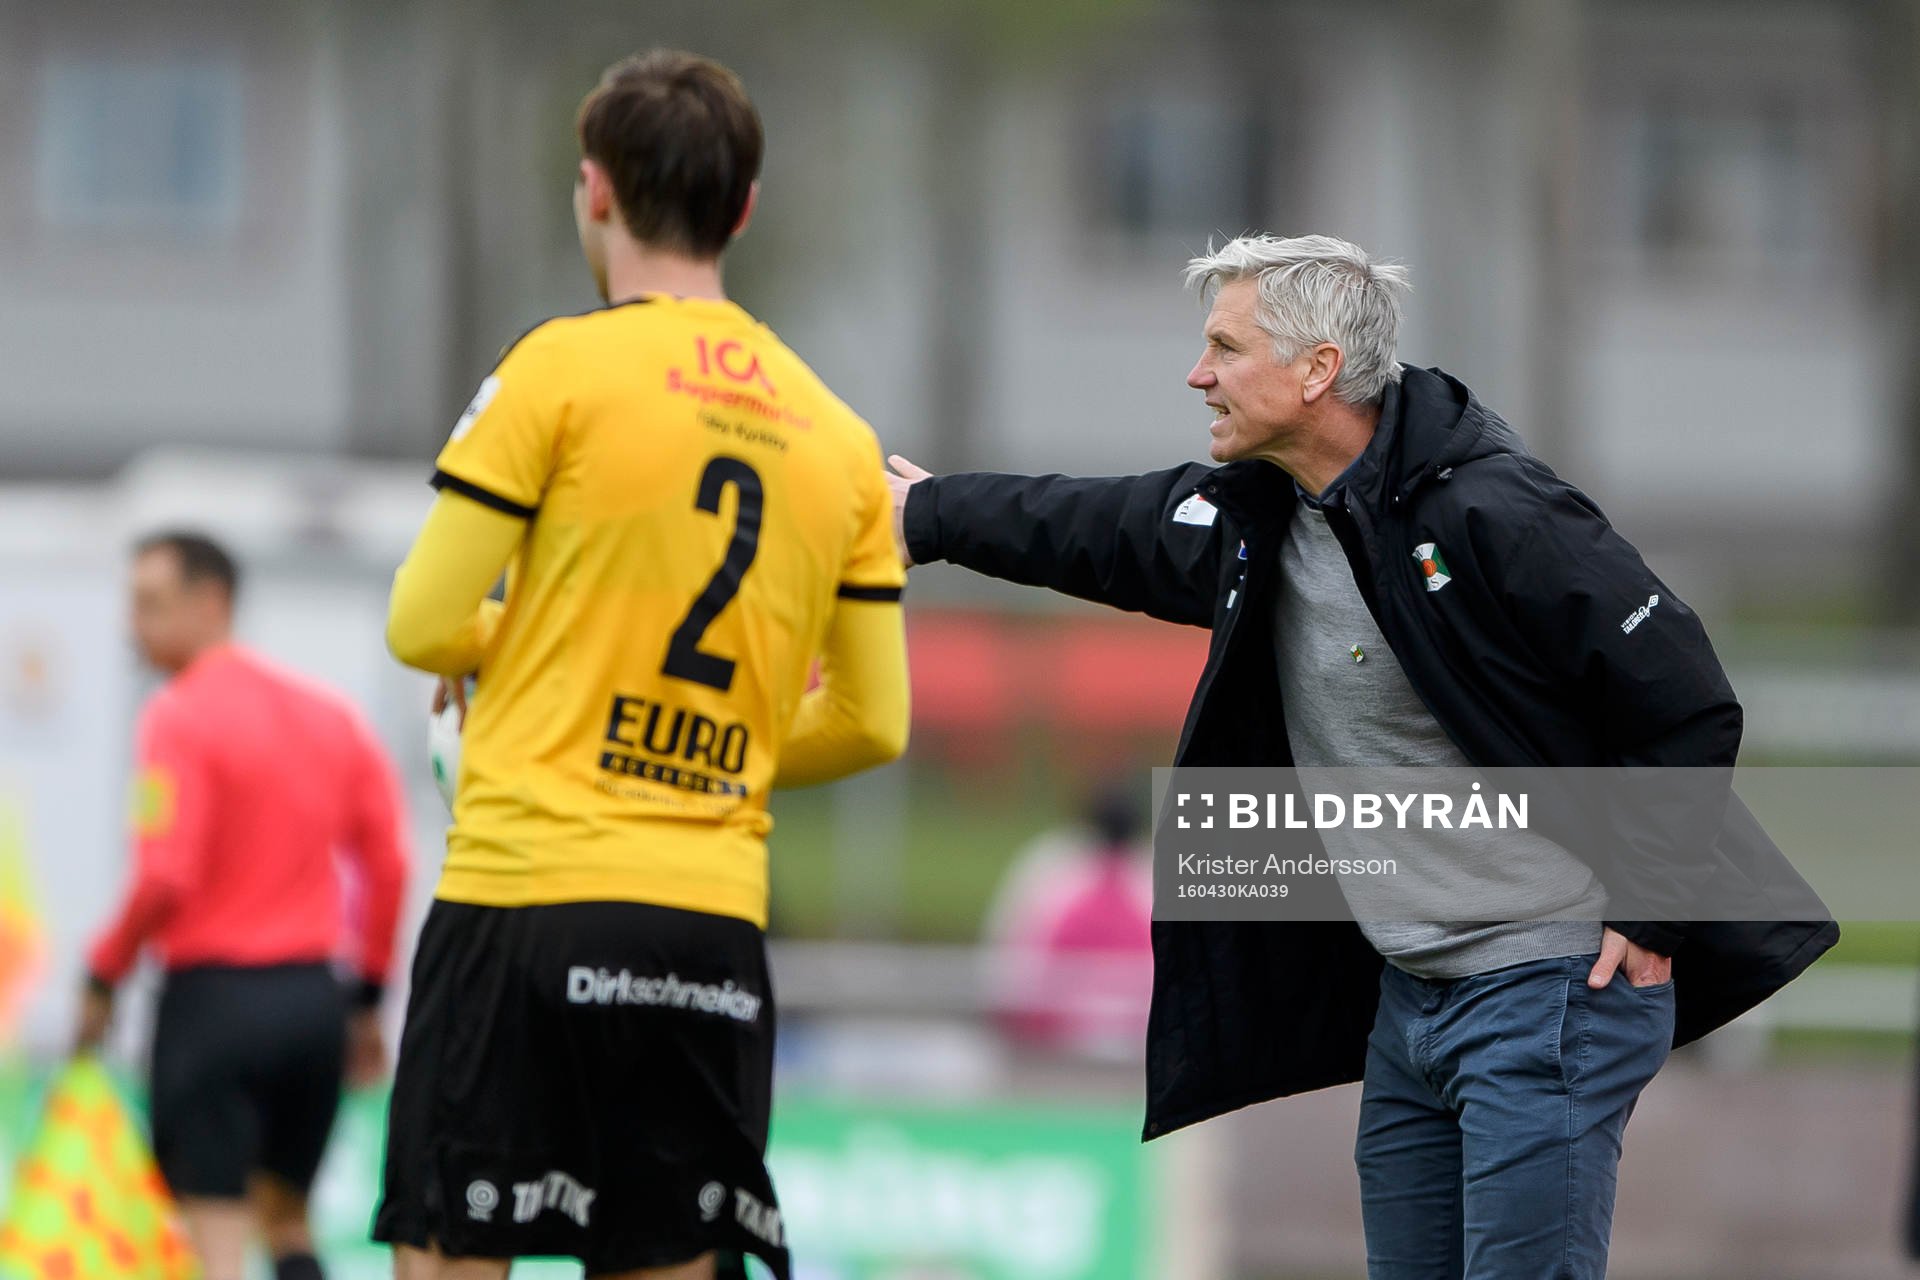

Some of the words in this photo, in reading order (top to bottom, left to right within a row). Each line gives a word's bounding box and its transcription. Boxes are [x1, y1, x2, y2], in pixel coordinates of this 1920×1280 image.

[694, 335, 777, 399] ICA
[662, 456, 764, 694] 2
[606, 696, 749, 775] EURO
